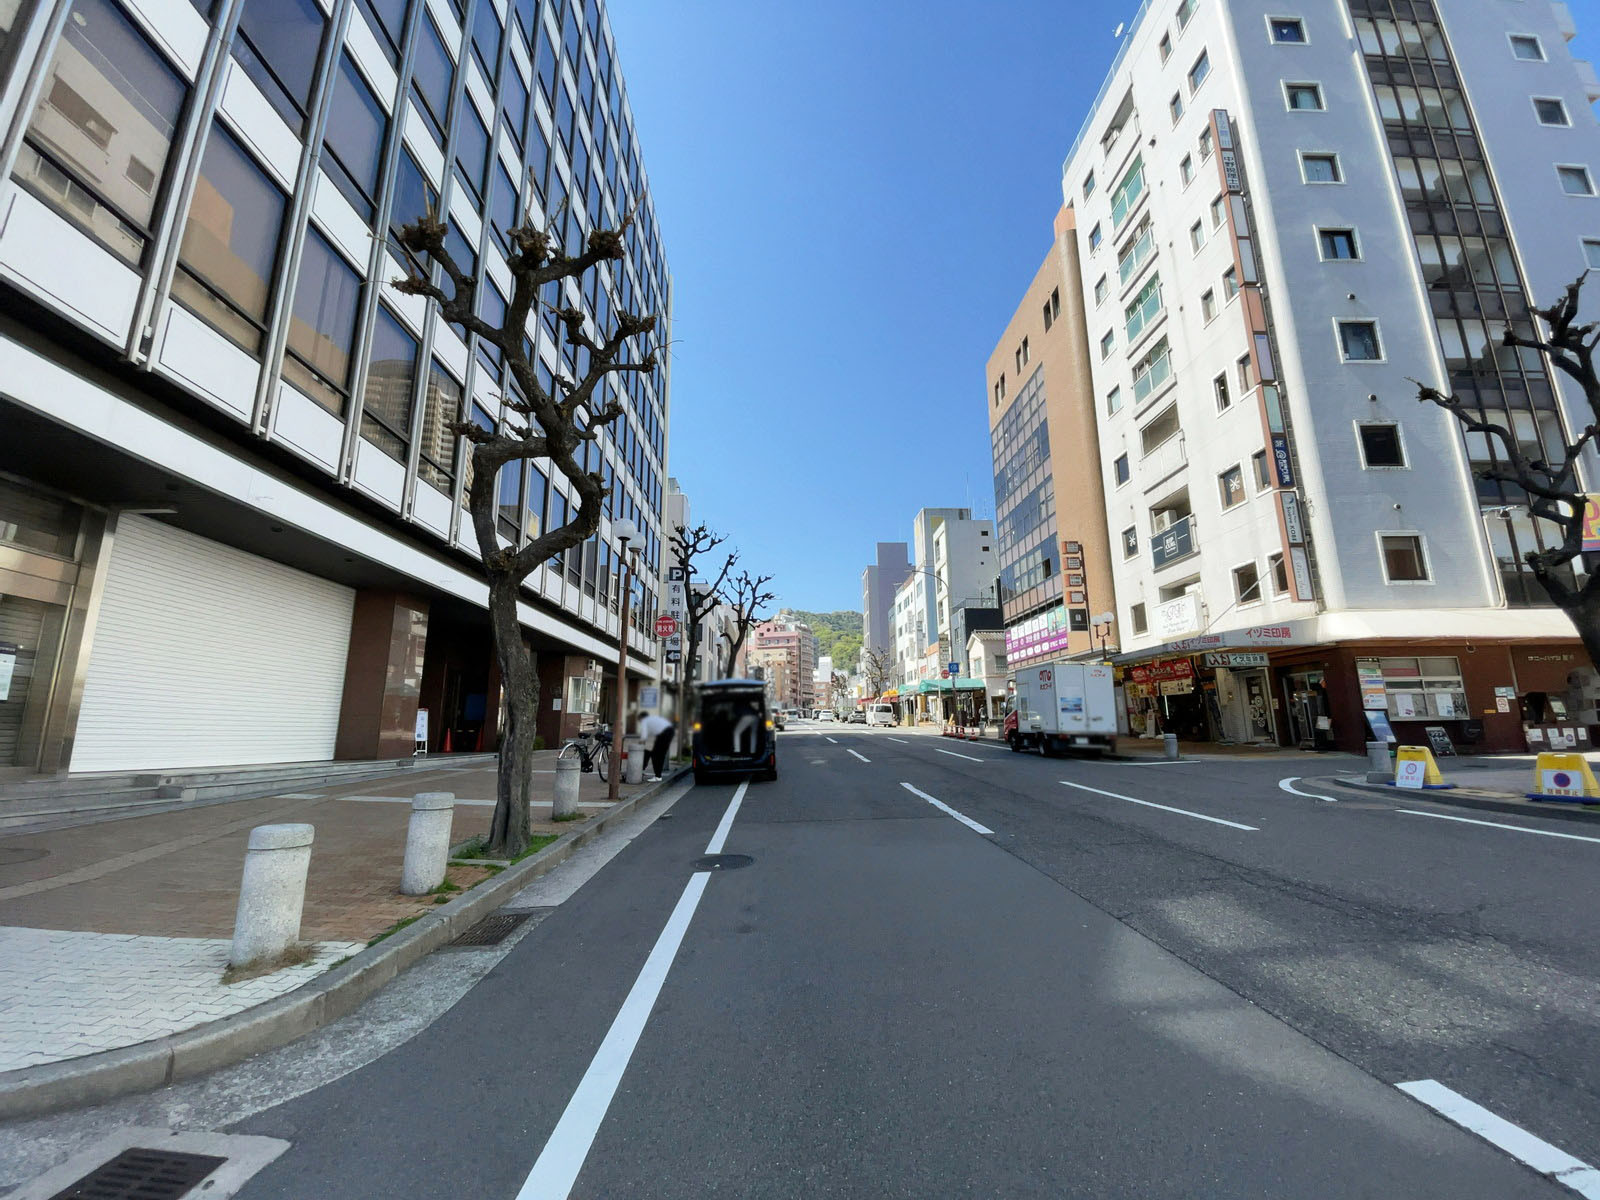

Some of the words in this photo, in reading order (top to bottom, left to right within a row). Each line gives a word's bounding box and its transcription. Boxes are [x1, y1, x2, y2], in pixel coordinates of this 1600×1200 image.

[673, 570, 682, 580] P
[671, 585, 680, 647] 有料駐場
